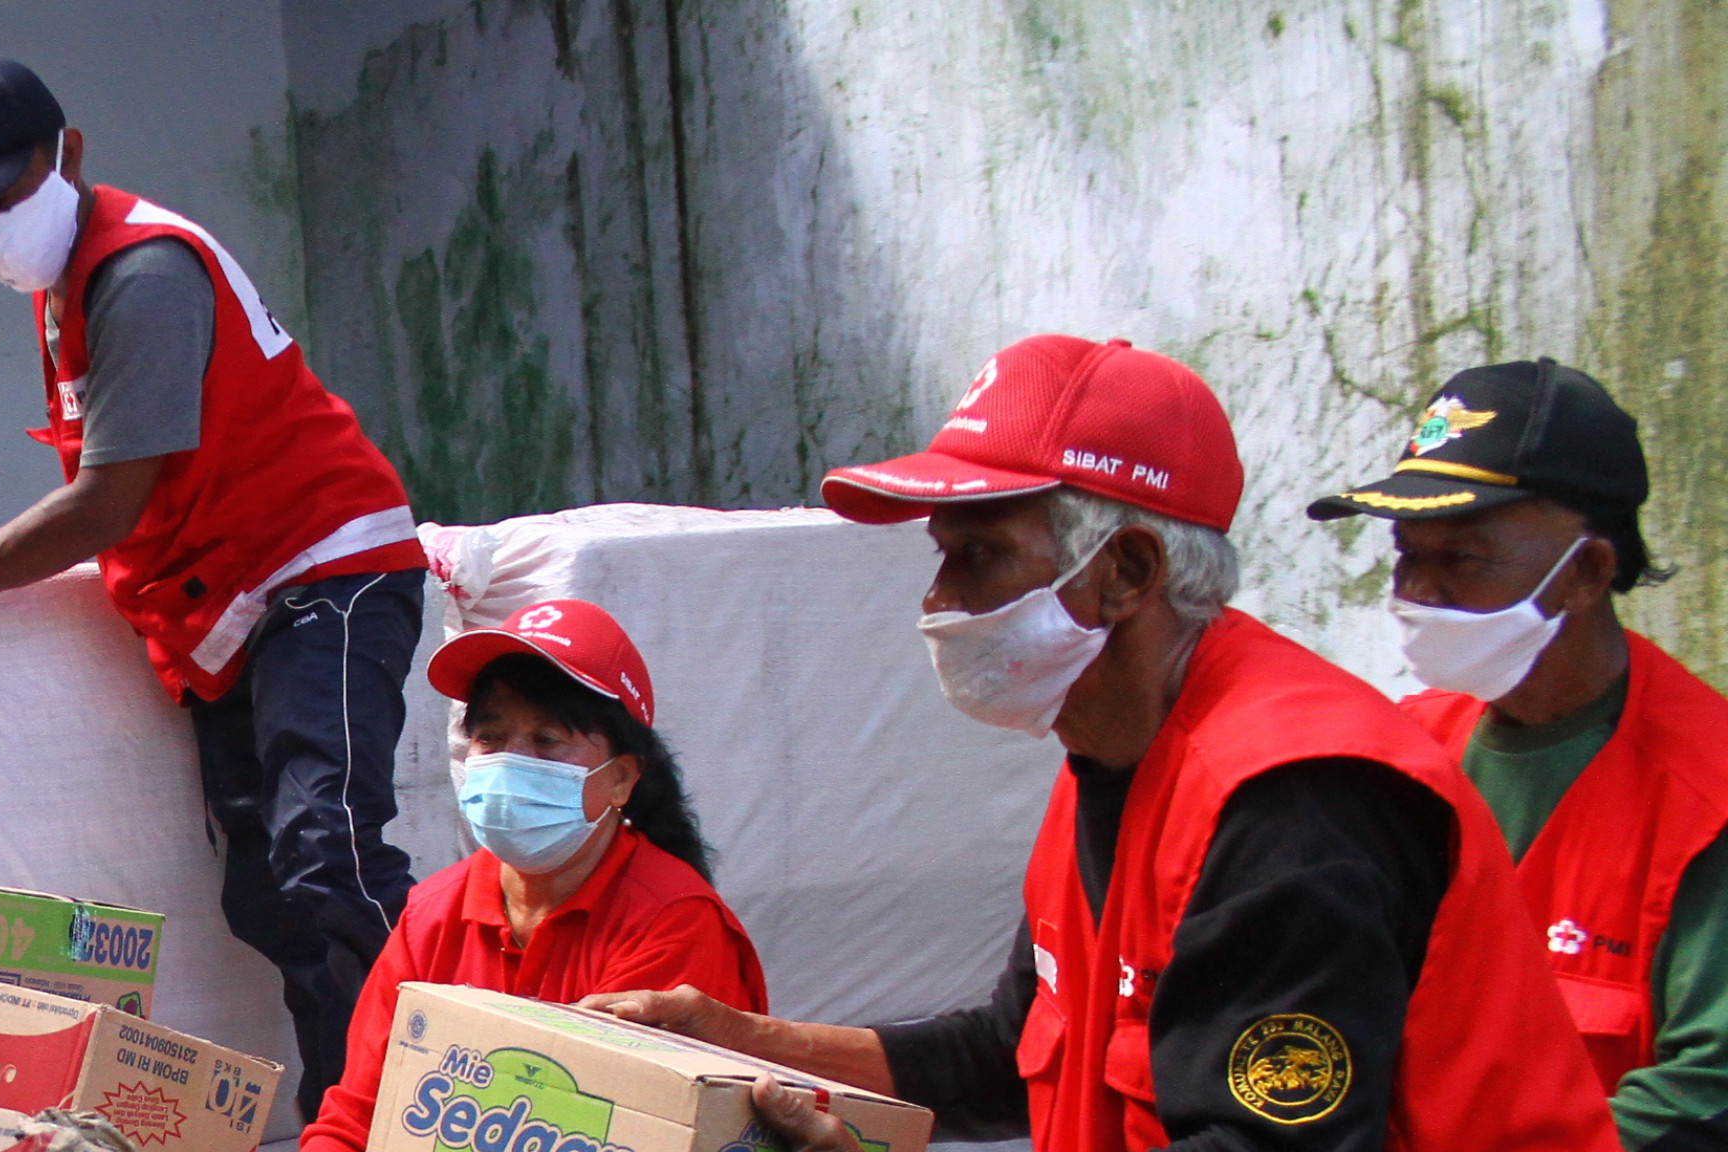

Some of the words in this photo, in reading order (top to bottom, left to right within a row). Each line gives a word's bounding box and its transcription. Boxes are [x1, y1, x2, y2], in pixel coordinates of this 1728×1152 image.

[1062, 449, 1123, 475] SIBAT
[1132, 463, 1169, 489] PMI
[1593, 934, 1631, 957] PMI
[116, 1048, 139, 1067] MD
[118, 1025, 199, 1063] 231509041002
[140, 1058, 159, 1074] RI
[160, 1066, 189, 1085] BPOM
[438, 1044, 494, 1089] Mie
[205, 1067, 262, 1124] 40
